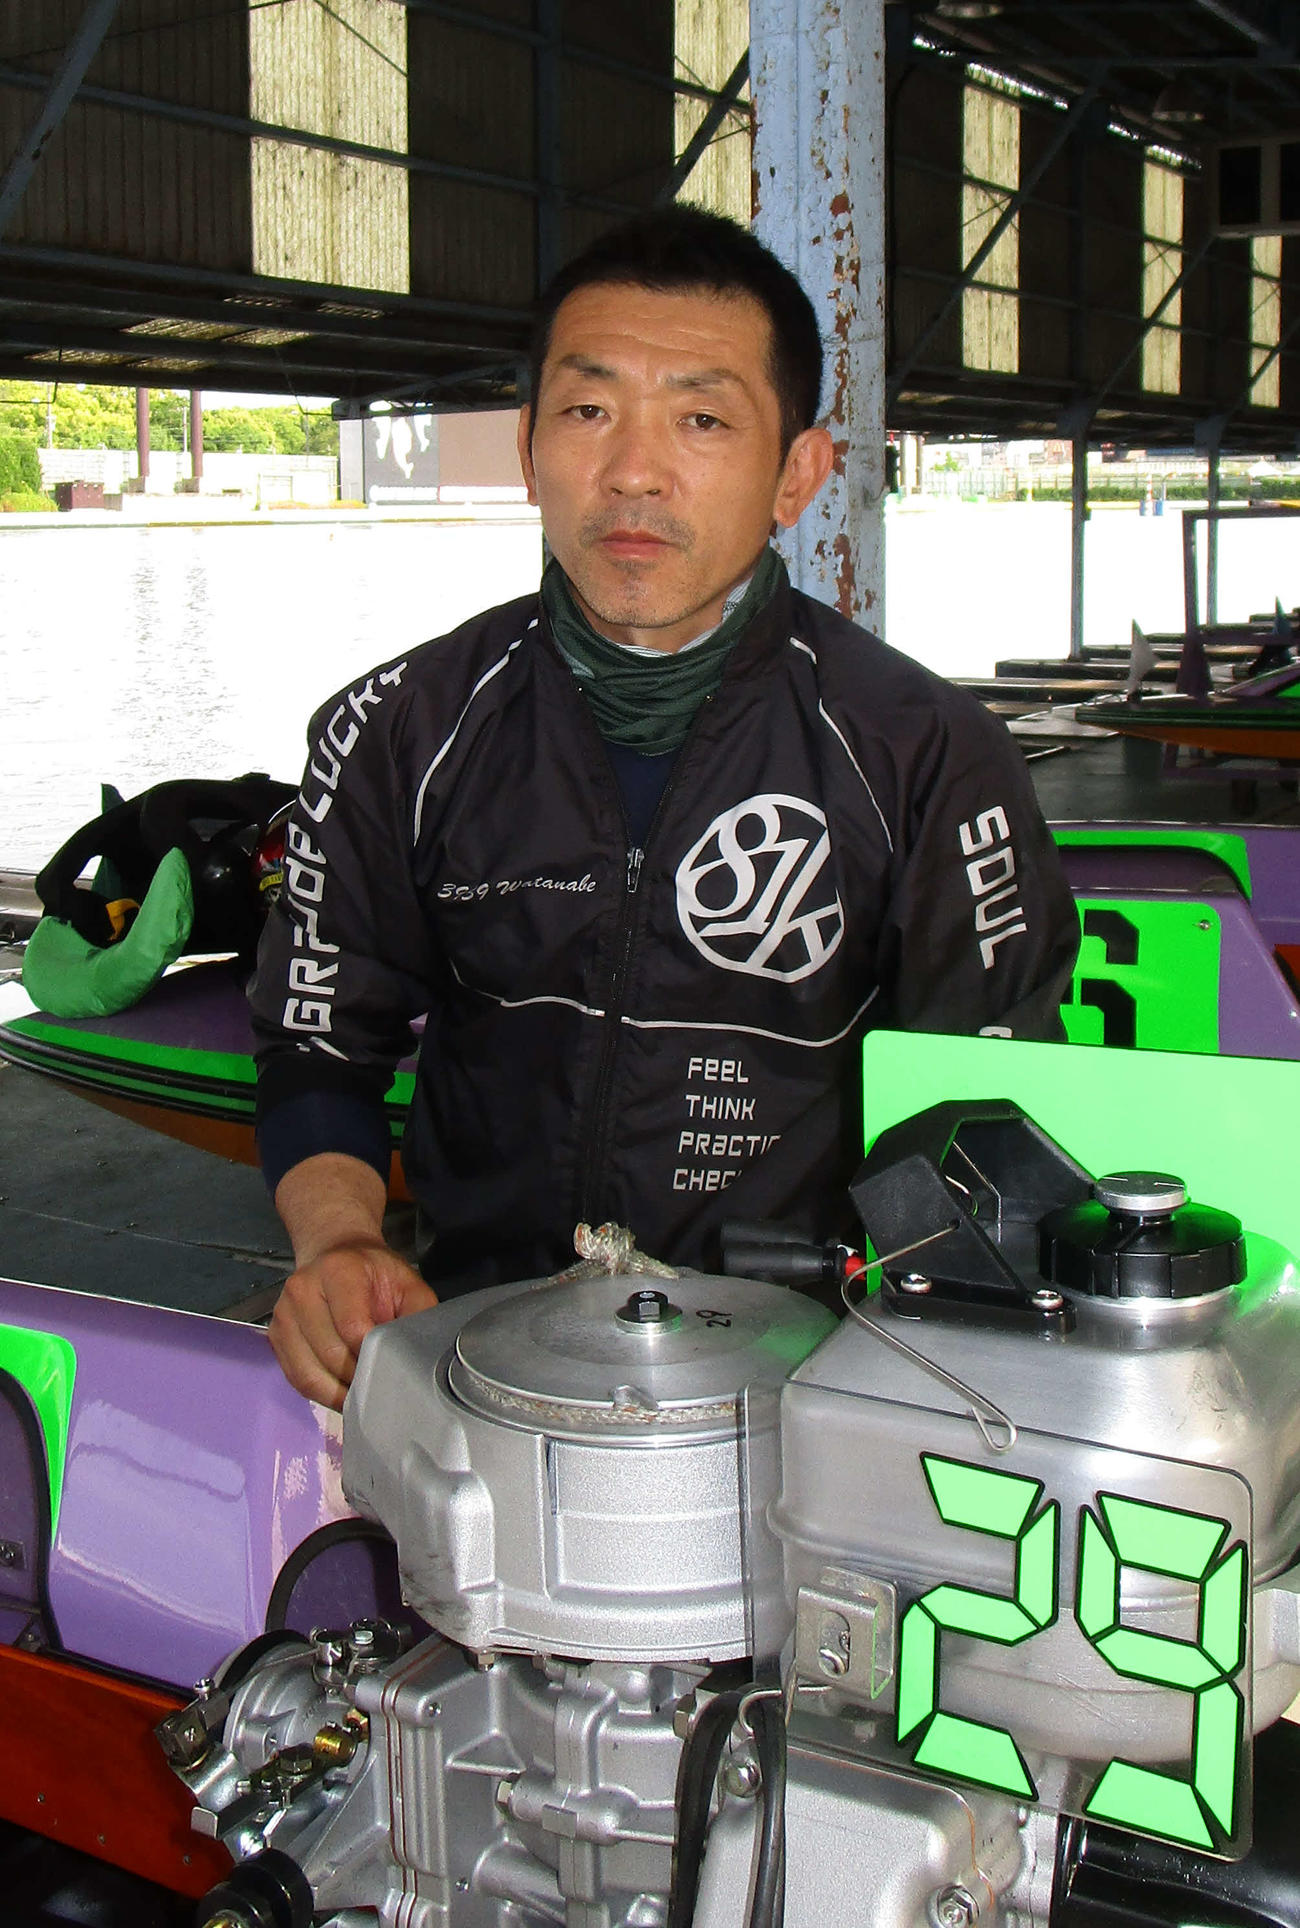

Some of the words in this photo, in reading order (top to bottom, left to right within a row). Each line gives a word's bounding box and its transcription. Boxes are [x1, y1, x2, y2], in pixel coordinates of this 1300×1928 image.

[298, 660, 408, 823] LUCKY
[495, 872, 597, 896] Watanabe
[957, 805, 1028, 970] SOUL
[687, 1056, 750, 1084] FEEL
[685, 1093, 756, 1121] THINK
[672, 1168, 743, 1192] CHEC
[695, 1308, 733, 1328] 29
[895, 1450, 1248, 1850] 29
